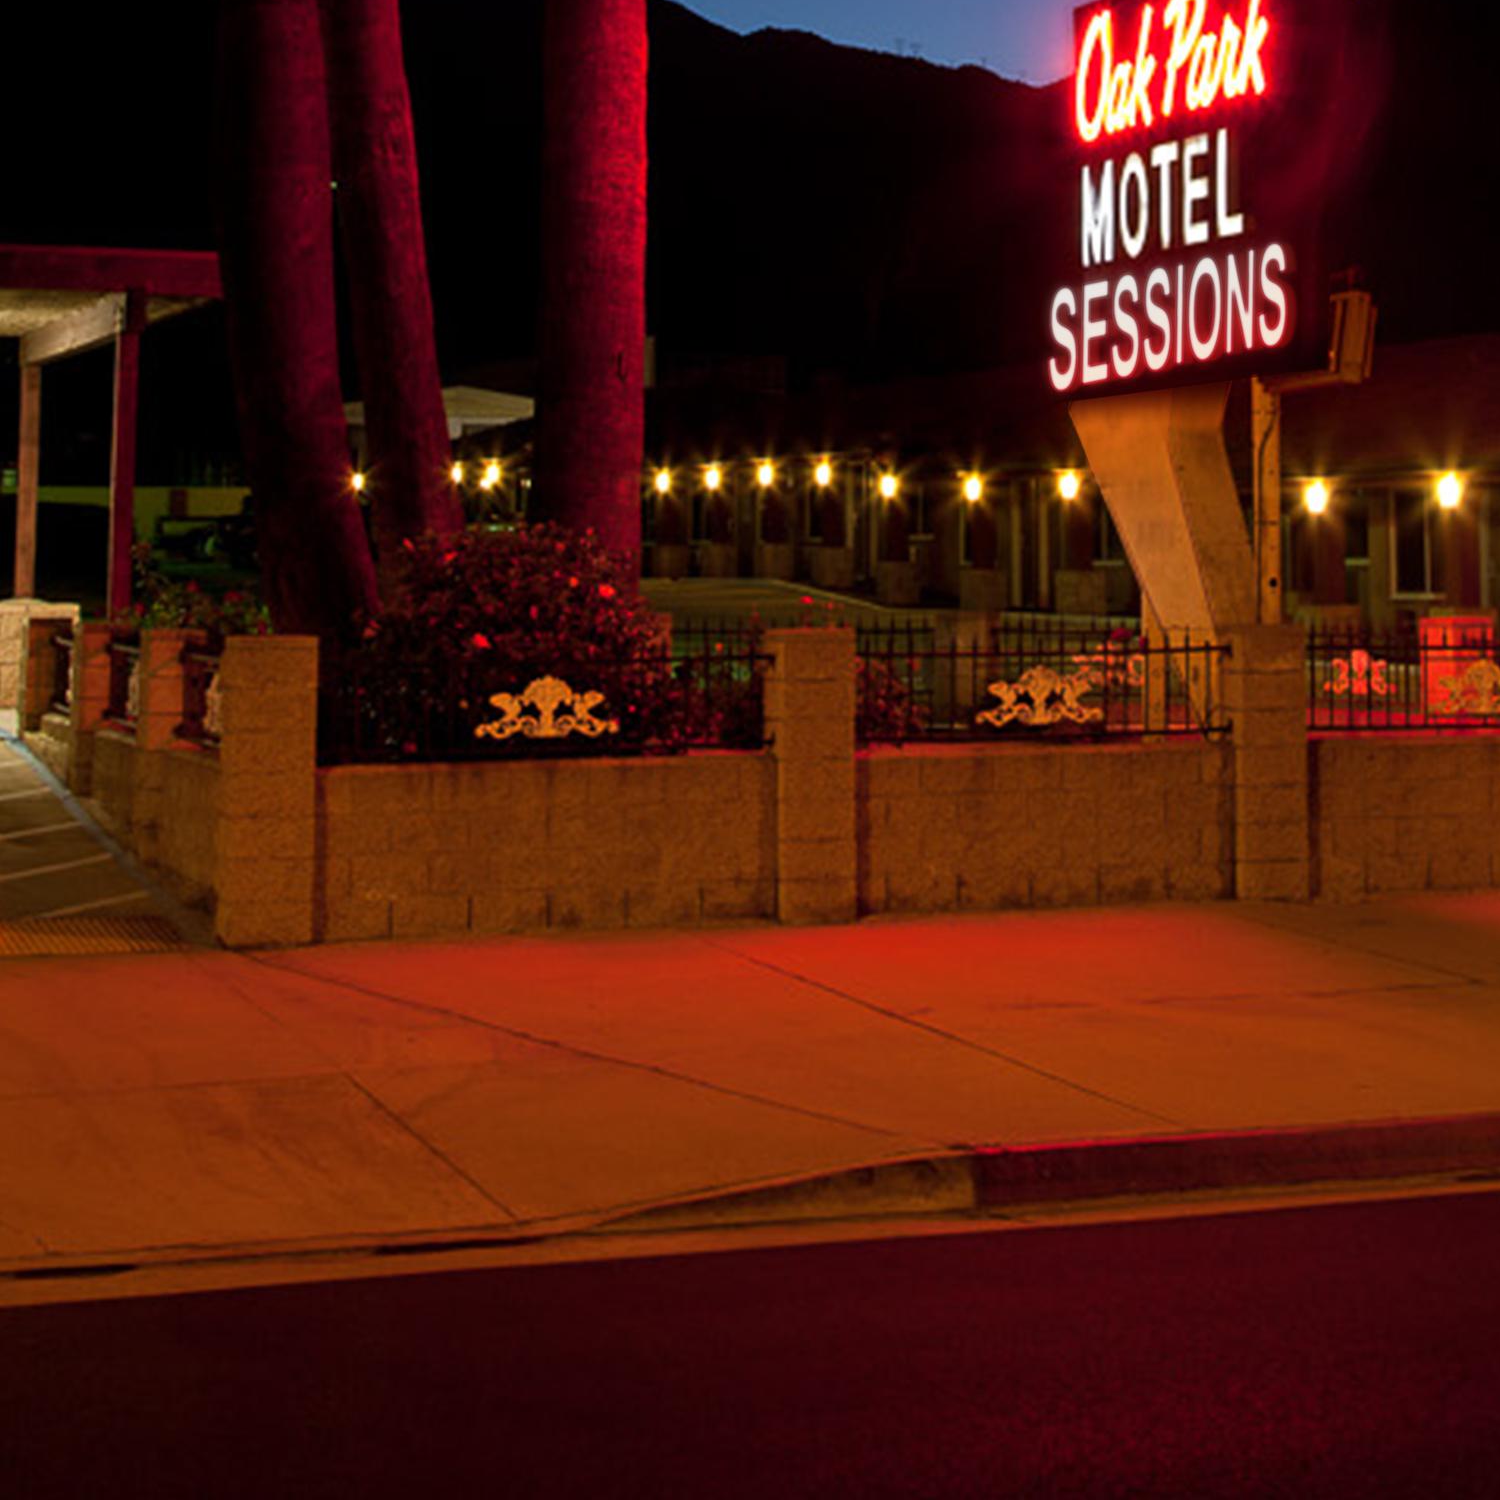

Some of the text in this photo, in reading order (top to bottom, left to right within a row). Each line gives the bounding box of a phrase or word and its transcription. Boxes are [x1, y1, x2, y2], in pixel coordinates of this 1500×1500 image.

[1075, 4, 1159, 143] Oak
[1081, 127, 1245, 268] MOTEL
[1049, 244, 1288, 391] SESSIONS
